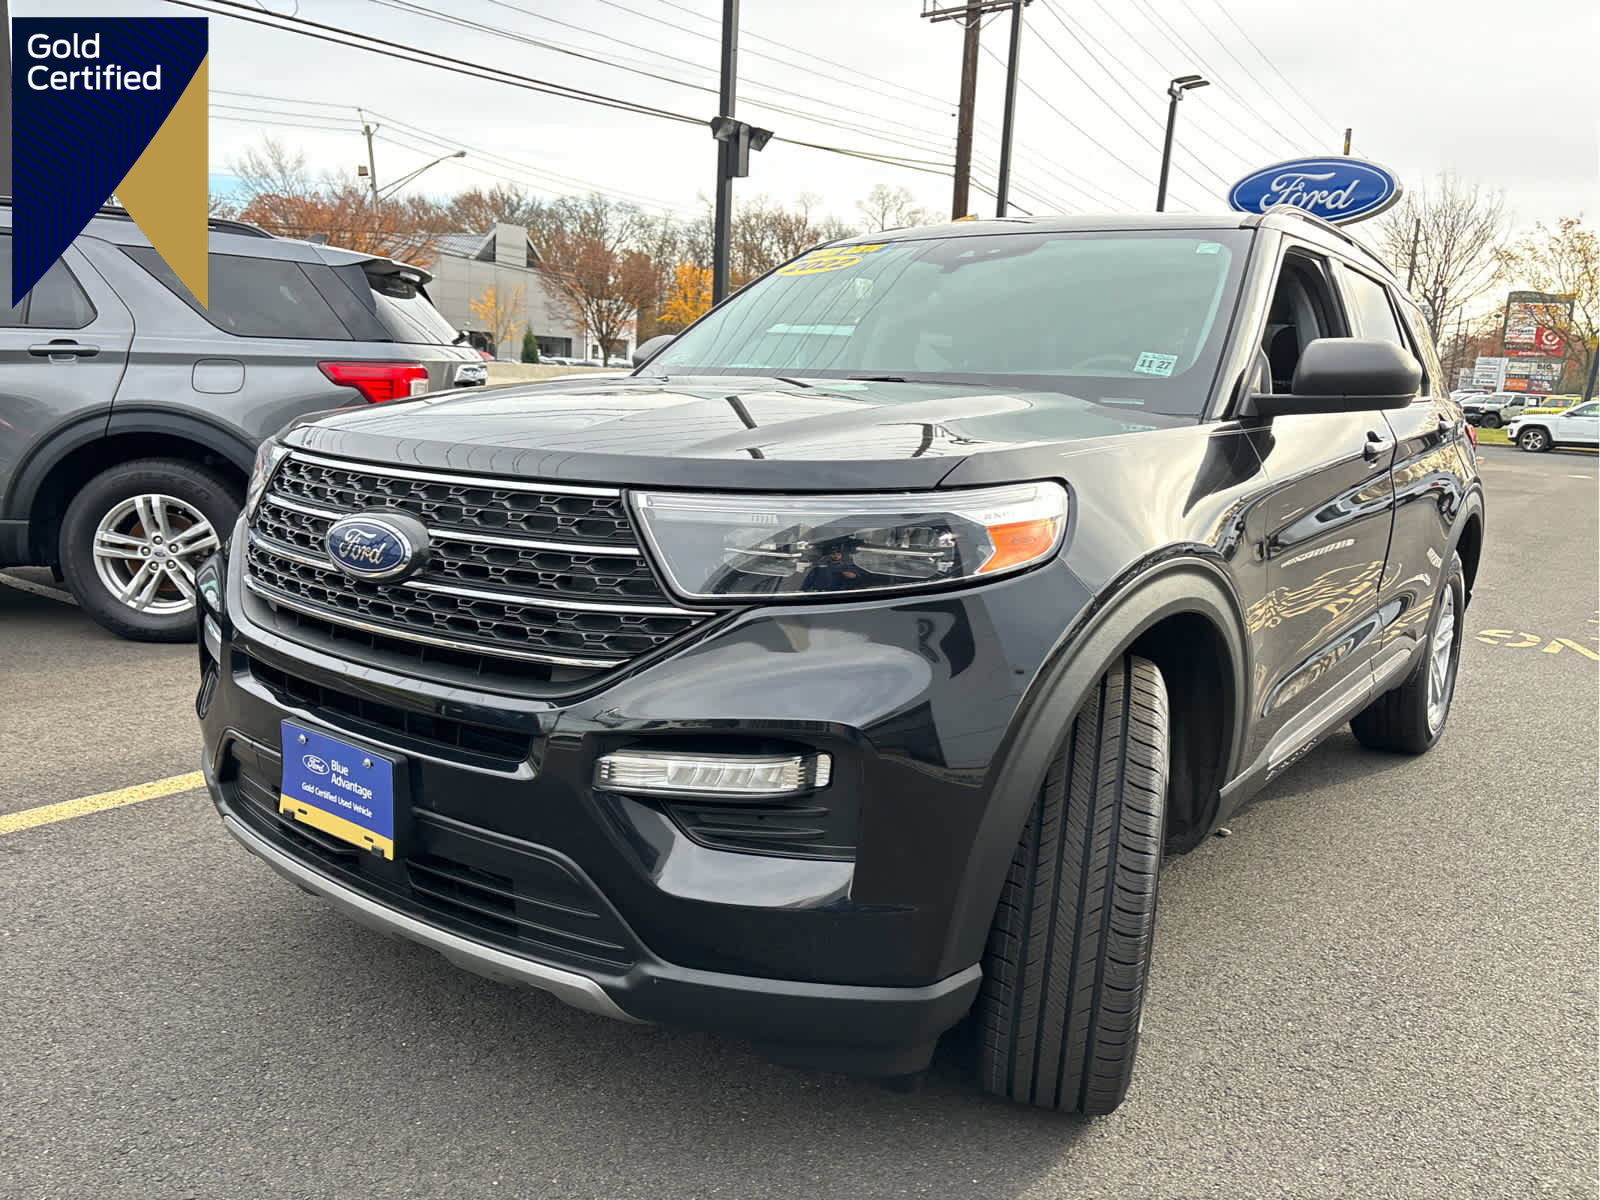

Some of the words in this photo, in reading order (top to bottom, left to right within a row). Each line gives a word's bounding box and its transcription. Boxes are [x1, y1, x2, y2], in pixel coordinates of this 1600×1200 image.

[1259, 172, 1360, 212] Ford
[1139, 359, 1154, 368] 11
[1156, 360, 1172, 370] 27
[339, 528, 386, 565] Ford
[307, 757, 325, 772] Ford
[331, 760, 349, 776] Blue
[331, 773, 373, 799] Advantage
[301, 782, 315, 794] Gold
[315, 787, 337, 802] Certified
[337, 796, 352, 809] Used
[352, 801, 373, 818] Vehicle
